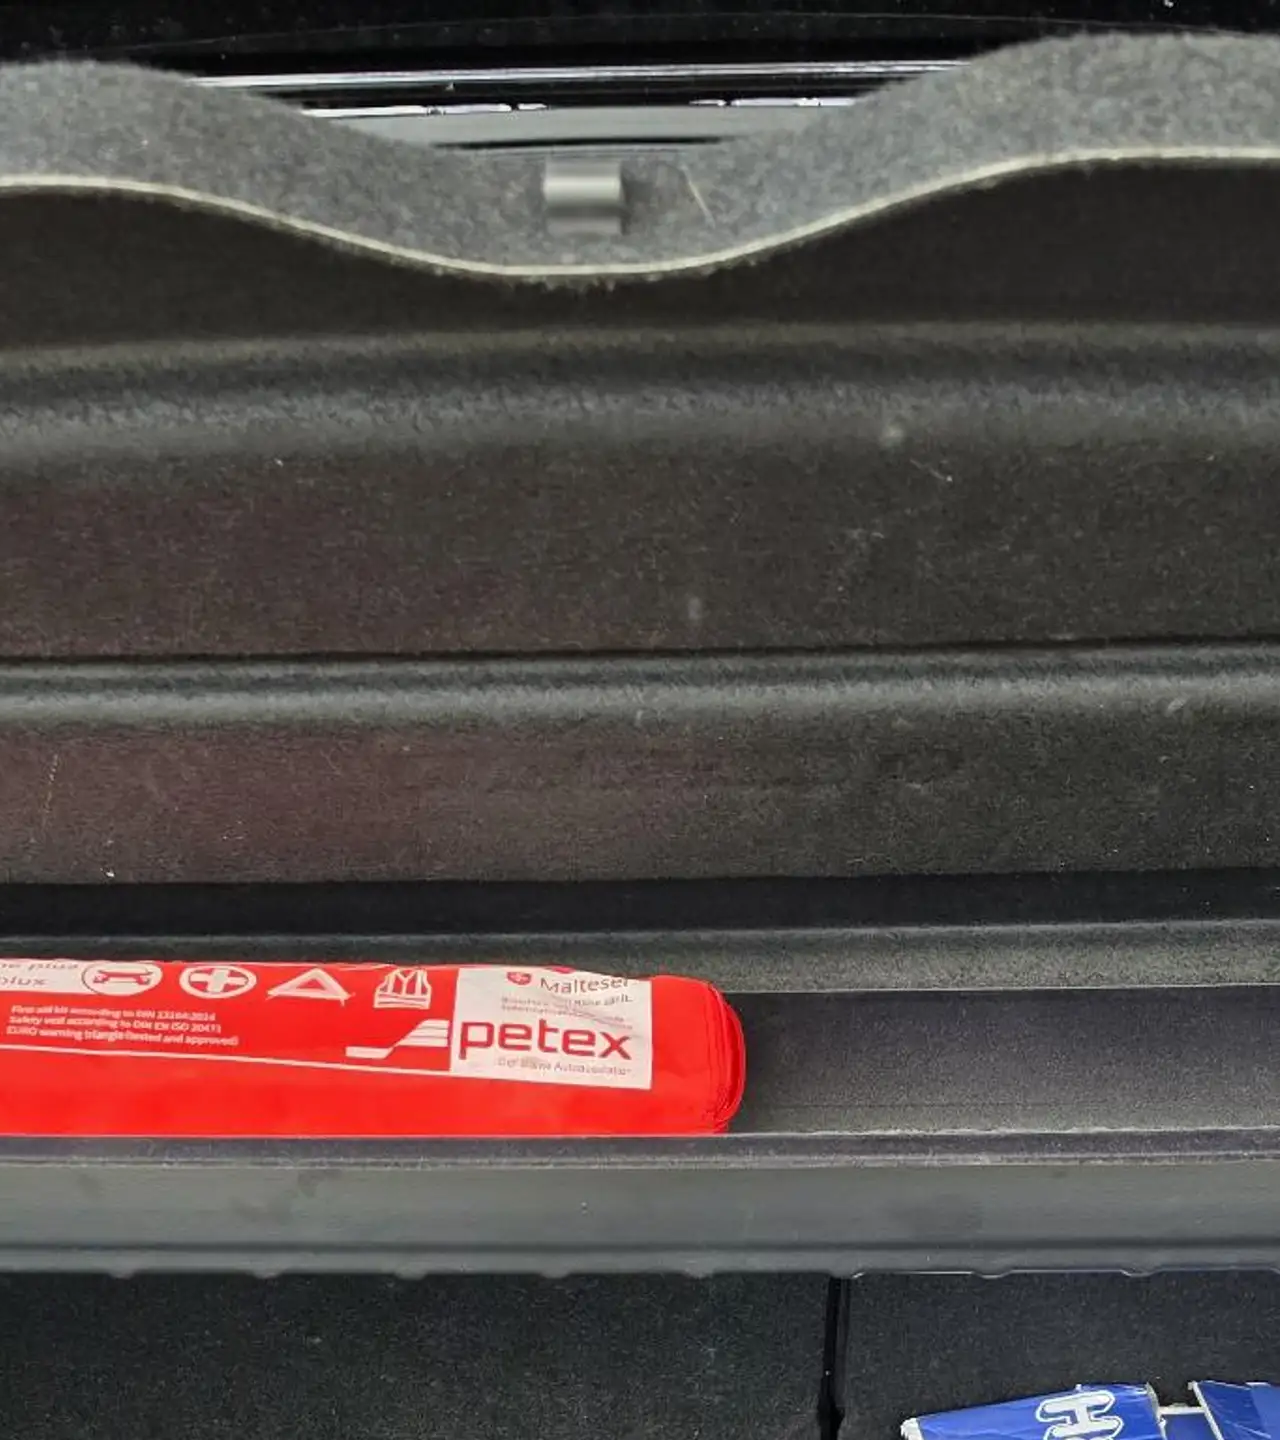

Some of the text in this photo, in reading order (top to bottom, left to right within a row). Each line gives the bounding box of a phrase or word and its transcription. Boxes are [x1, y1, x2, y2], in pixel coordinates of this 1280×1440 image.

[540, 977, 629, 994] Malteser
[9, 1015, 43, 1026] Safety
[459, 1018, 631, 1060] petex
